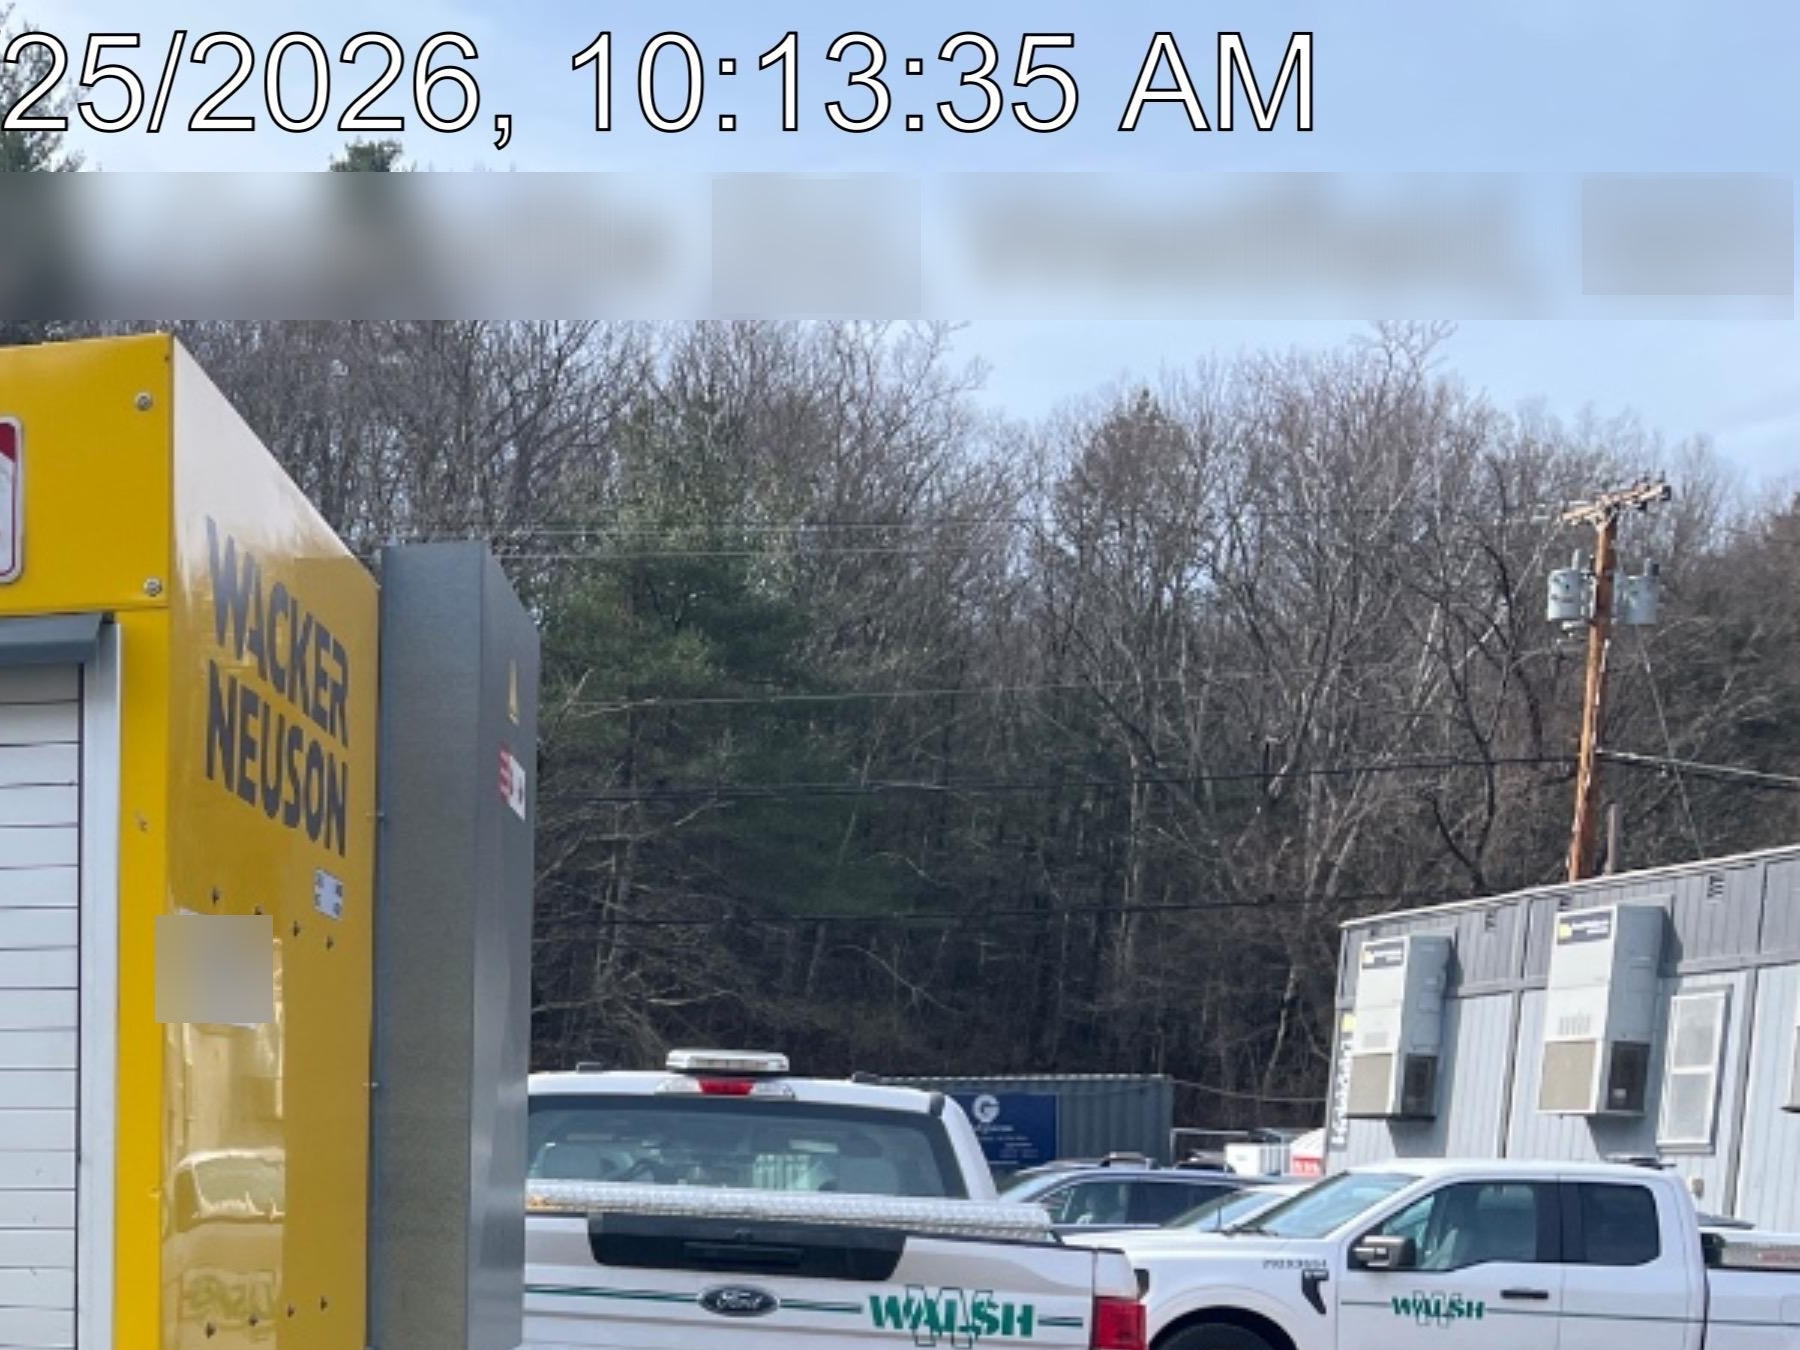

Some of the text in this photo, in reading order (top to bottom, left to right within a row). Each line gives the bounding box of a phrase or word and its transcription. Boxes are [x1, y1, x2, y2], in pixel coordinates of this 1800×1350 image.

[205, 514, 350, 747] WACKER
[205, 657, 347, 857] NEUSON
[869, 1295, 1034, 1337] WALSH
[1391, 1296, 1485, 1320] WALSH
